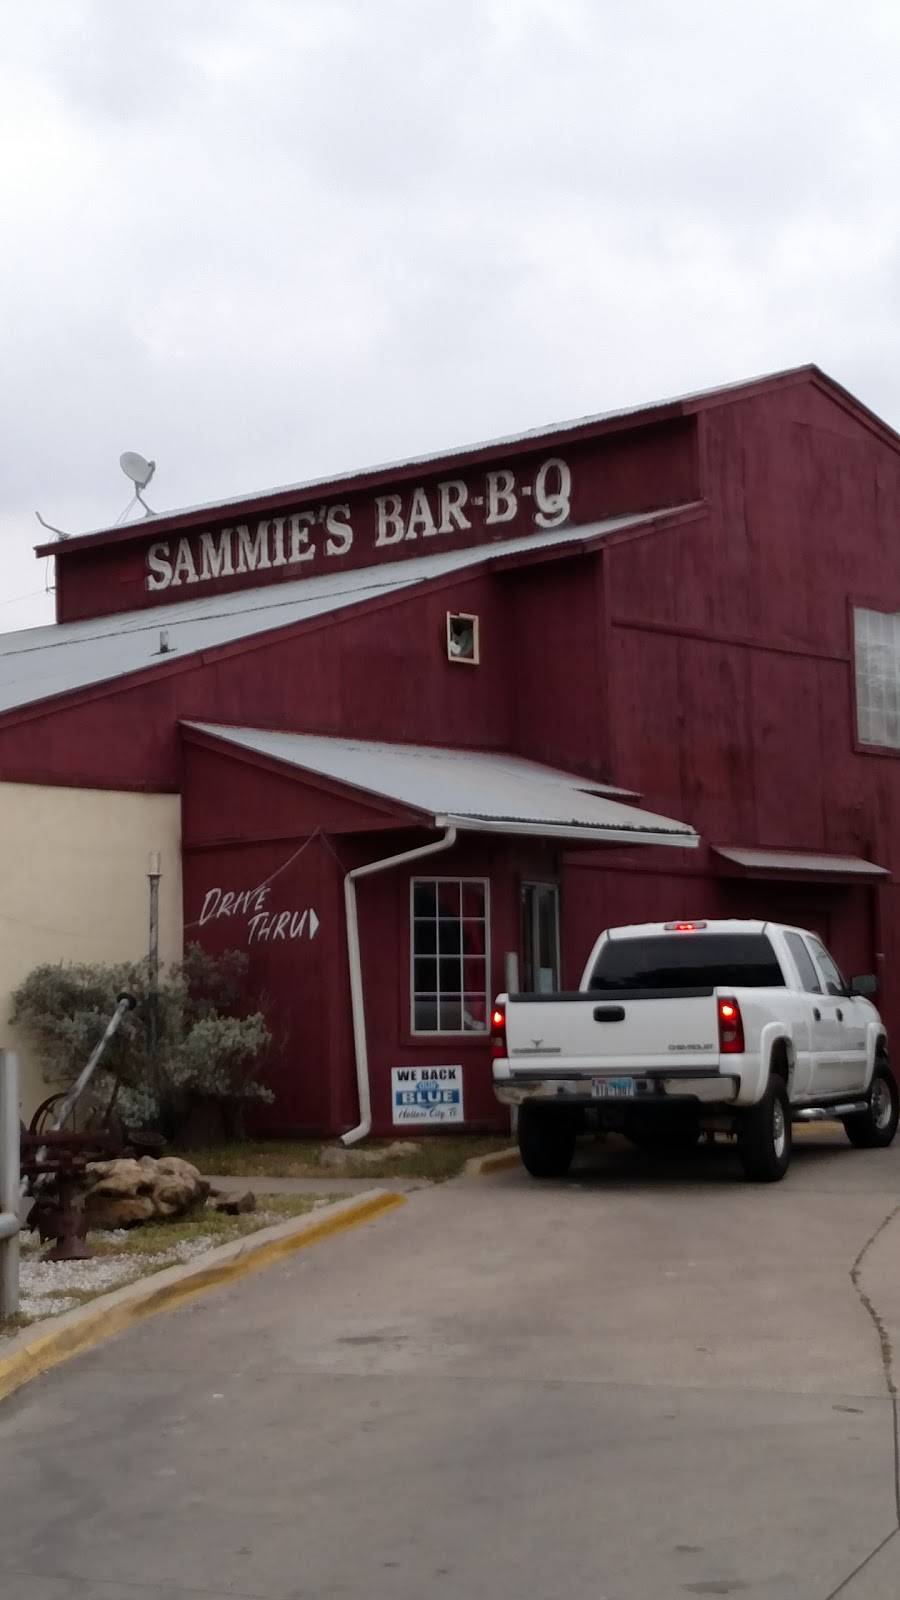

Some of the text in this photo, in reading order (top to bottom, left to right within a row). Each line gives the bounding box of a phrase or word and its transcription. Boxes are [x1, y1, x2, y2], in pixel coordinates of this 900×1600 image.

[145, 457, 572, 591] SAMMIE'S BAR-B-Q
[199, 886, 271, 926] DRIVE
[248, 909, 308, 945] THRU
[397, 1068, 456, 1081] WE BACK
[401, 1088, 454, 1104] BLUE
